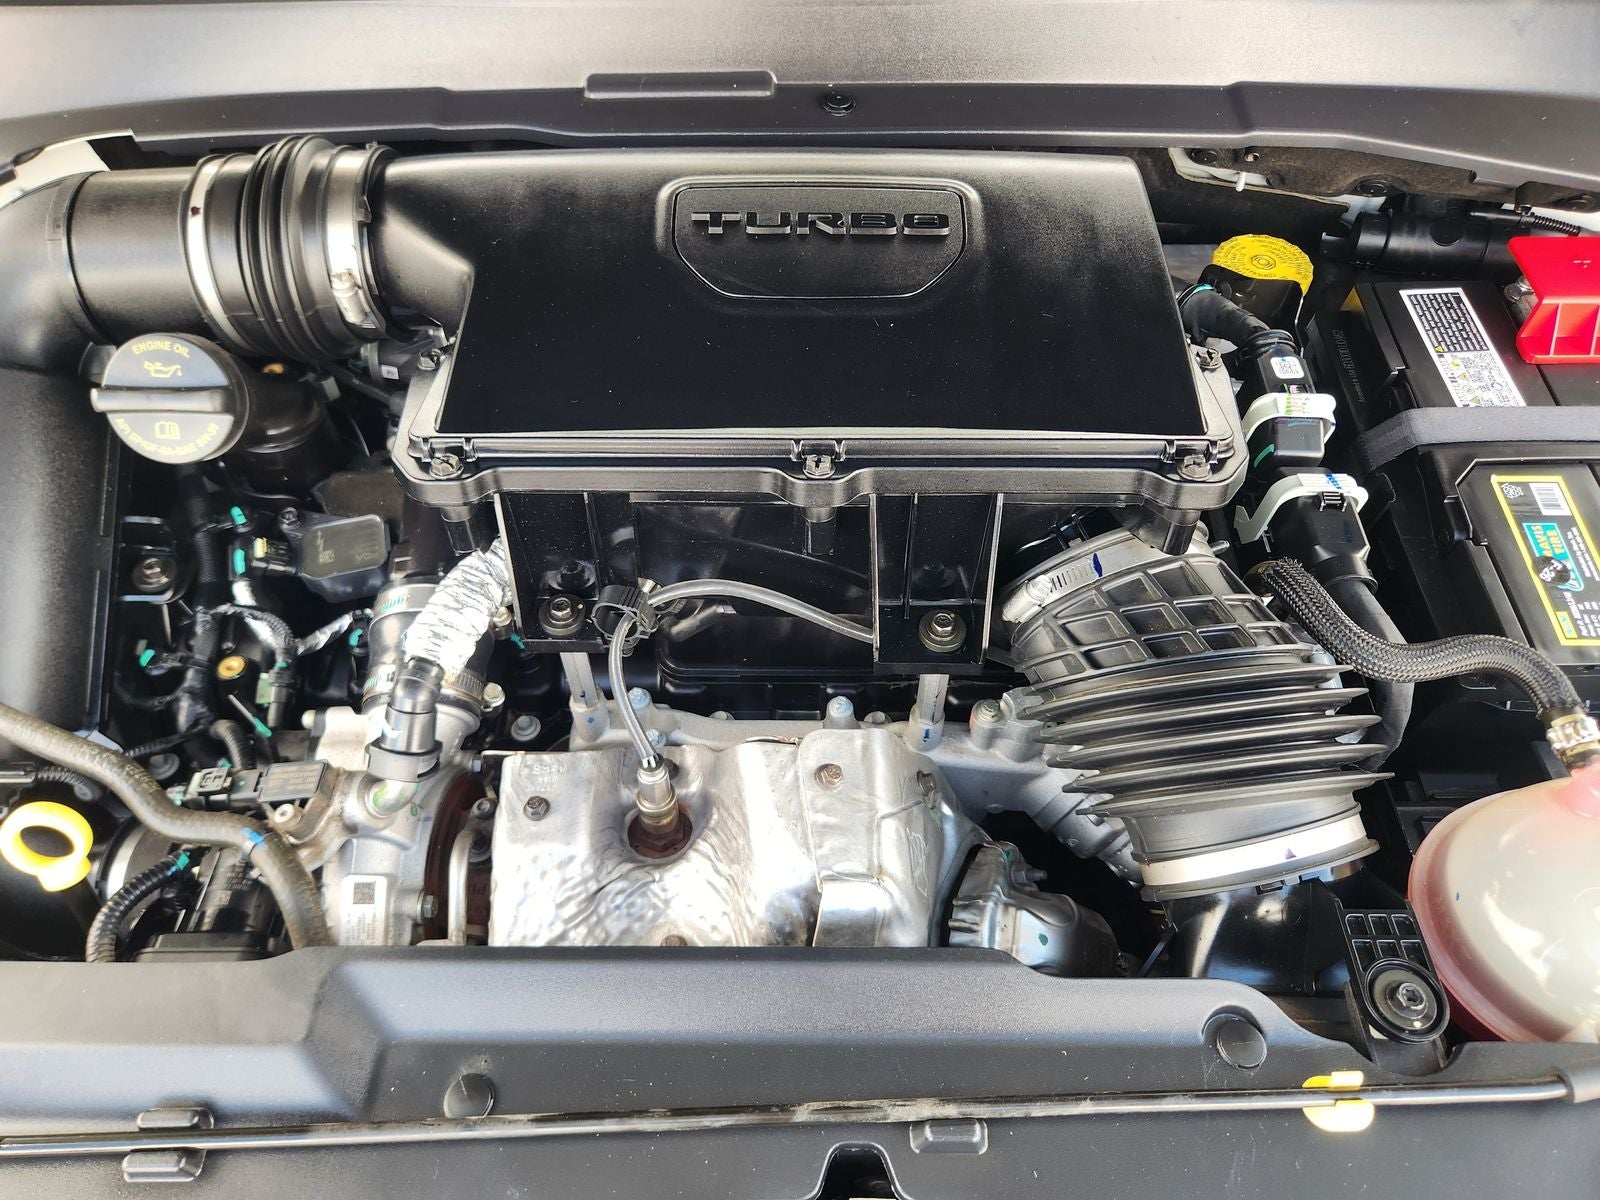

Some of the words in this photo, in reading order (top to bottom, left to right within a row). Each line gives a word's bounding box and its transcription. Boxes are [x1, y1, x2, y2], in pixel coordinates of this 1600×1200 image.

[691, 211, 950, 236] TURBO
[131, 340, 173, 356] ENGINE
[173, 342, 191, 359] OIL
[1546, 529, 1565, 555] TIRE
[1539, 559, 1563, 582] F-26
